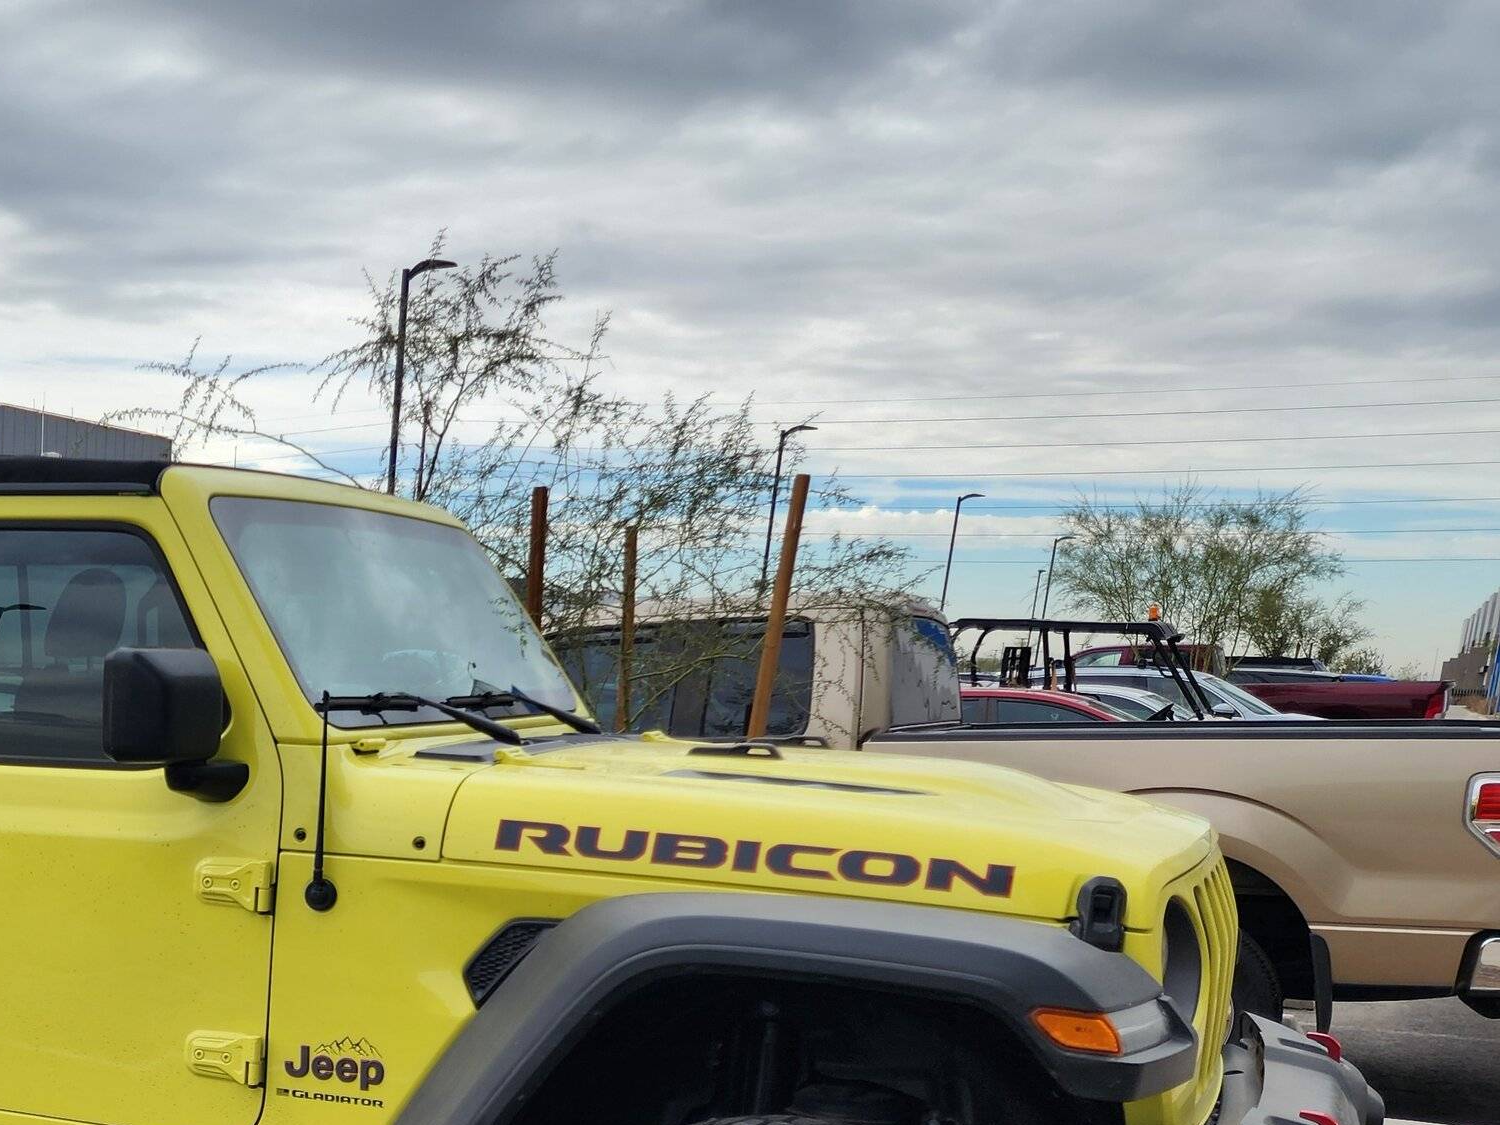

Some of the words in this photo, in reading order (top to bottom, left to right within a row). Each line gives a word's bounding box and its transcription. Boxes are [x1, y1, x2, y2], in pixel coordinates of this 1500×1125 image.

[494, 818, 1016, 899] RUBICON
[284, 1044, 385, 1091] Jeep
[291, 1088, 385, 1108] GLADIATOR
